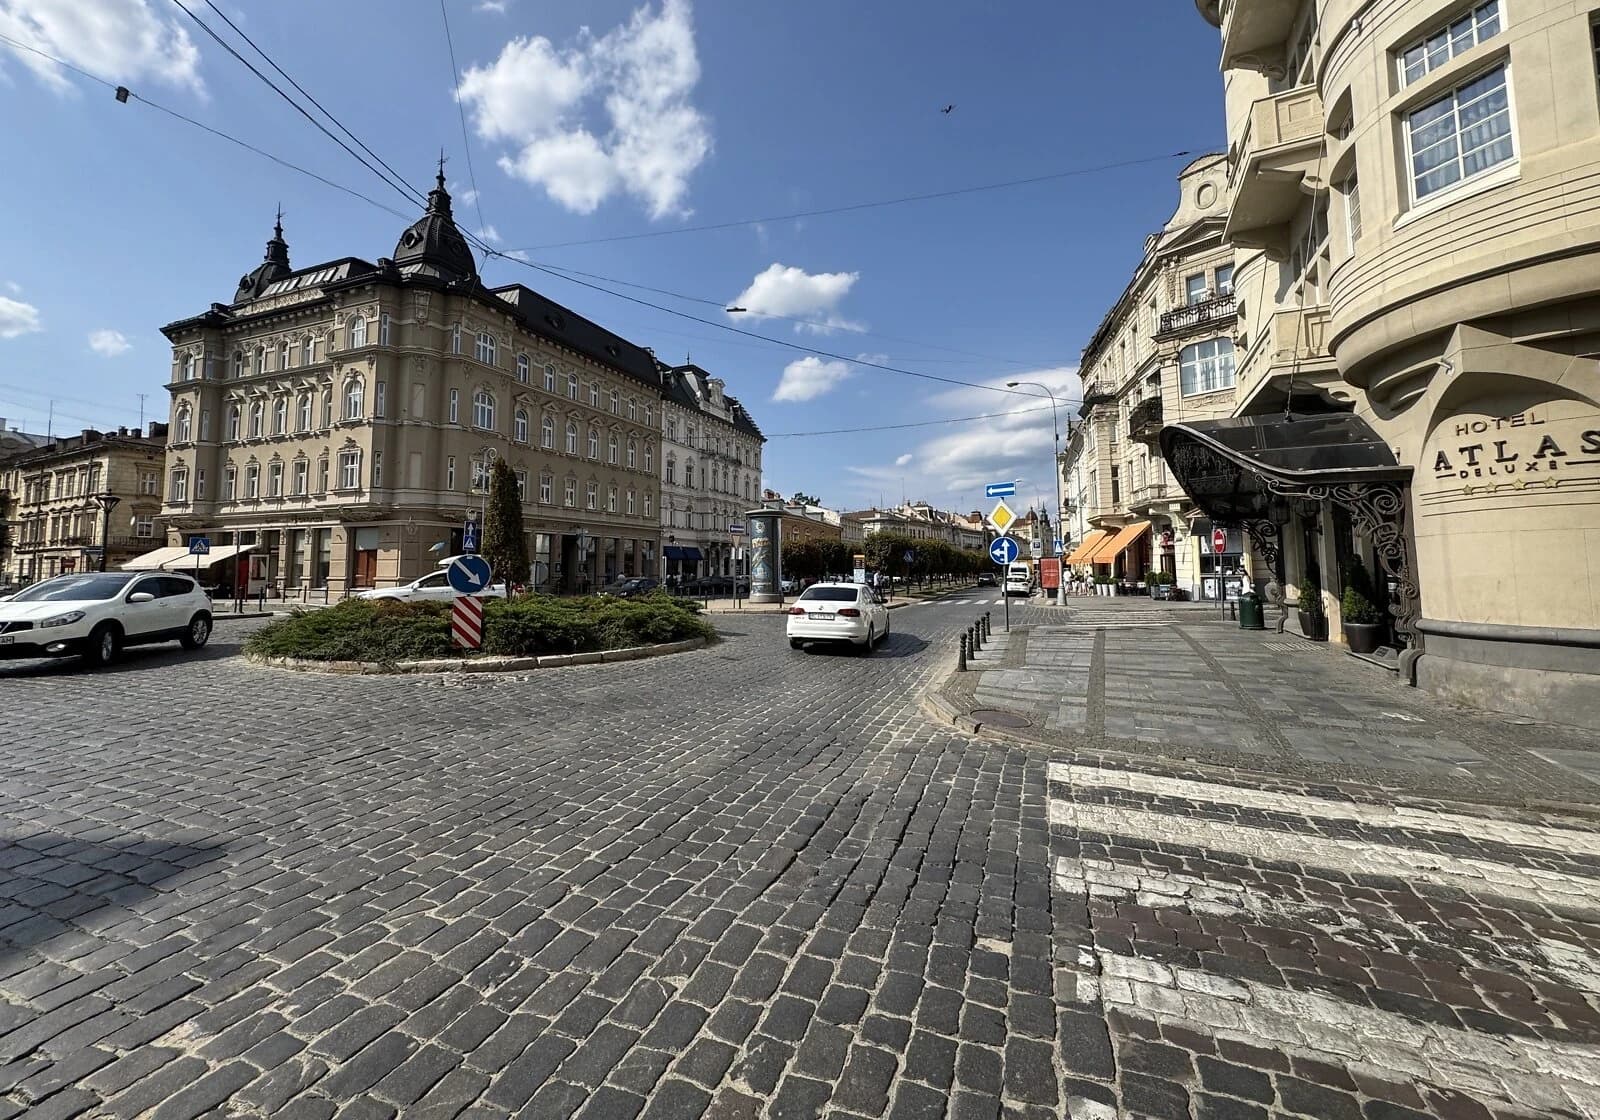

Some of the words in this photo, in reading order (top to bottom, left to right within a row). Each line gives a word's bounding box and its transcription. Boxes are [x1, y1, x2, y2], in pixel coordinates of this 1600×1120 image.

[1456, 412, 1545, 436] HOTEL
[1434, 430, 1600, 471] ATLAS
[1460, 460, 1557, 479] DELUXE
